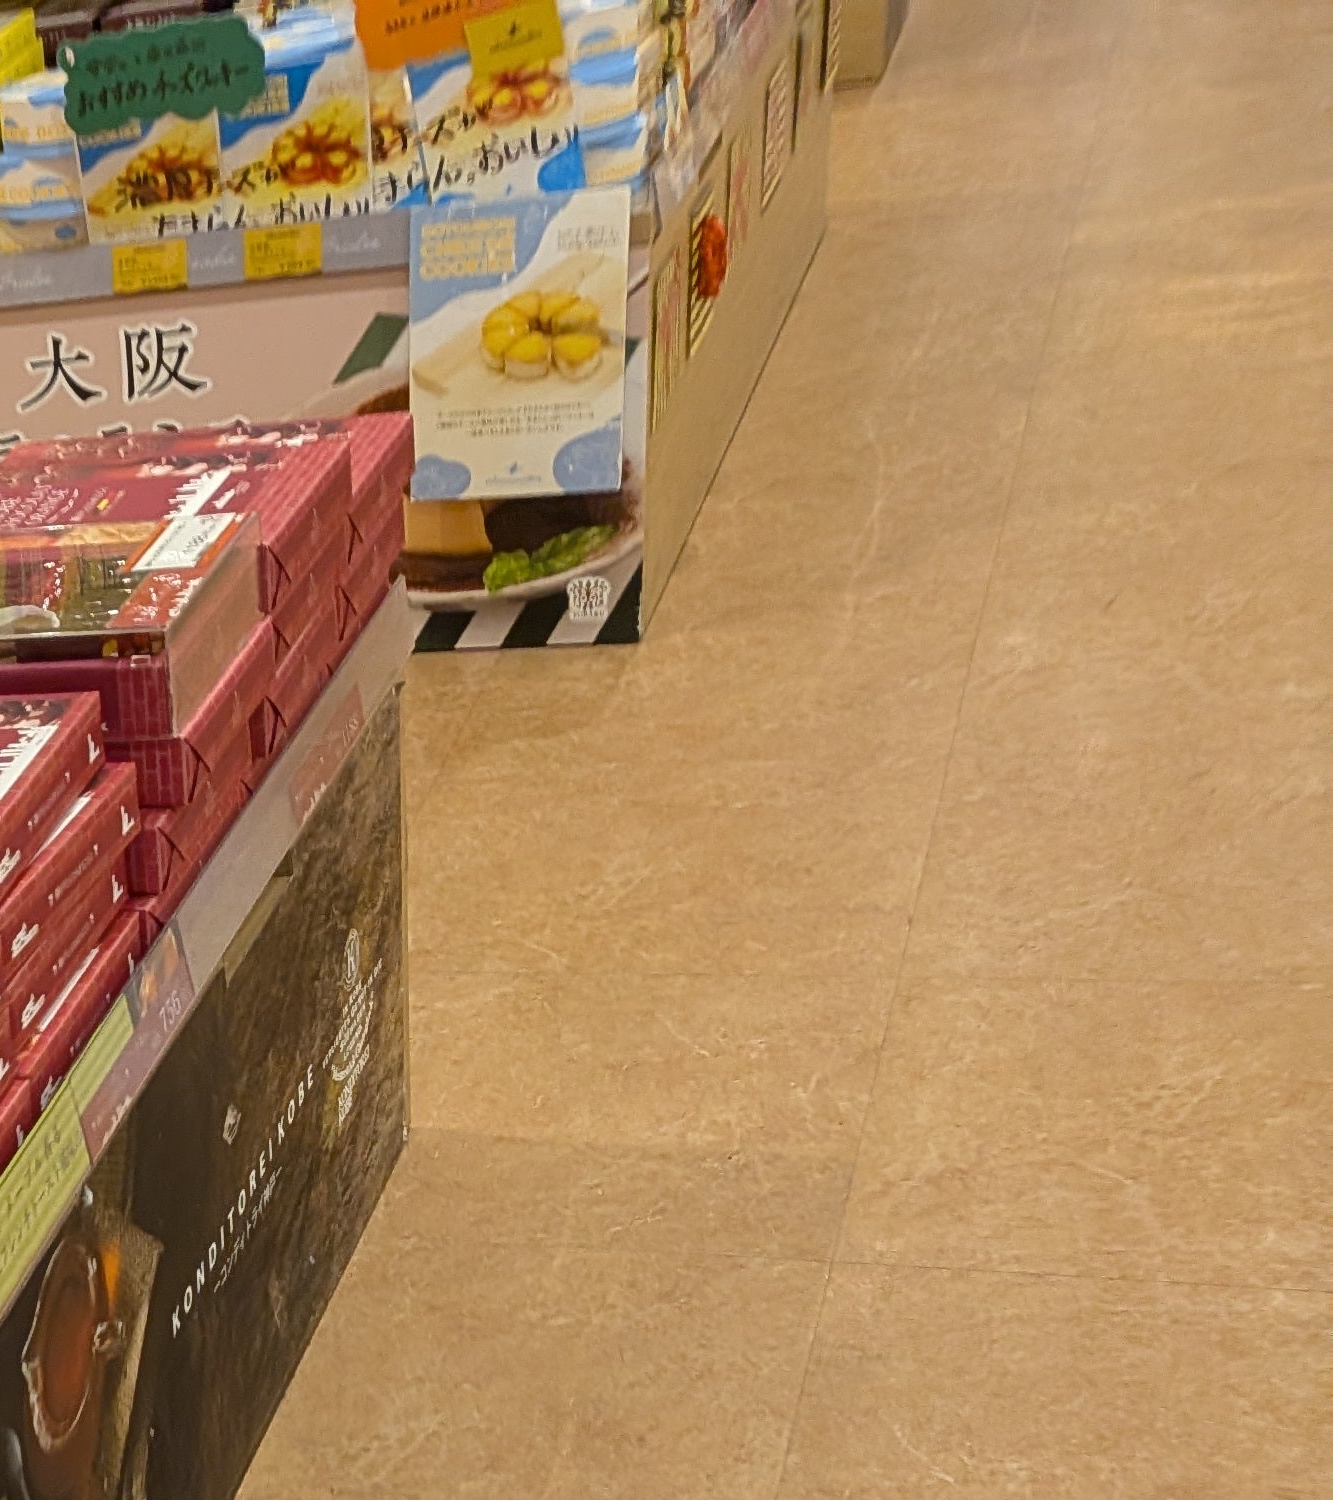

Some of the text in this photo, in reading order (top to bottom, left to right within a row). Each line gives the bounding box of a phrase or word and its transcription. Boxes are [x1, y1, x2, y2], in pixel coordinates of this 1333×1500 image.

[20, 323, 208, 411] 大阪
[172, 1063, 314, 1339] KONDITOREI KOBE
